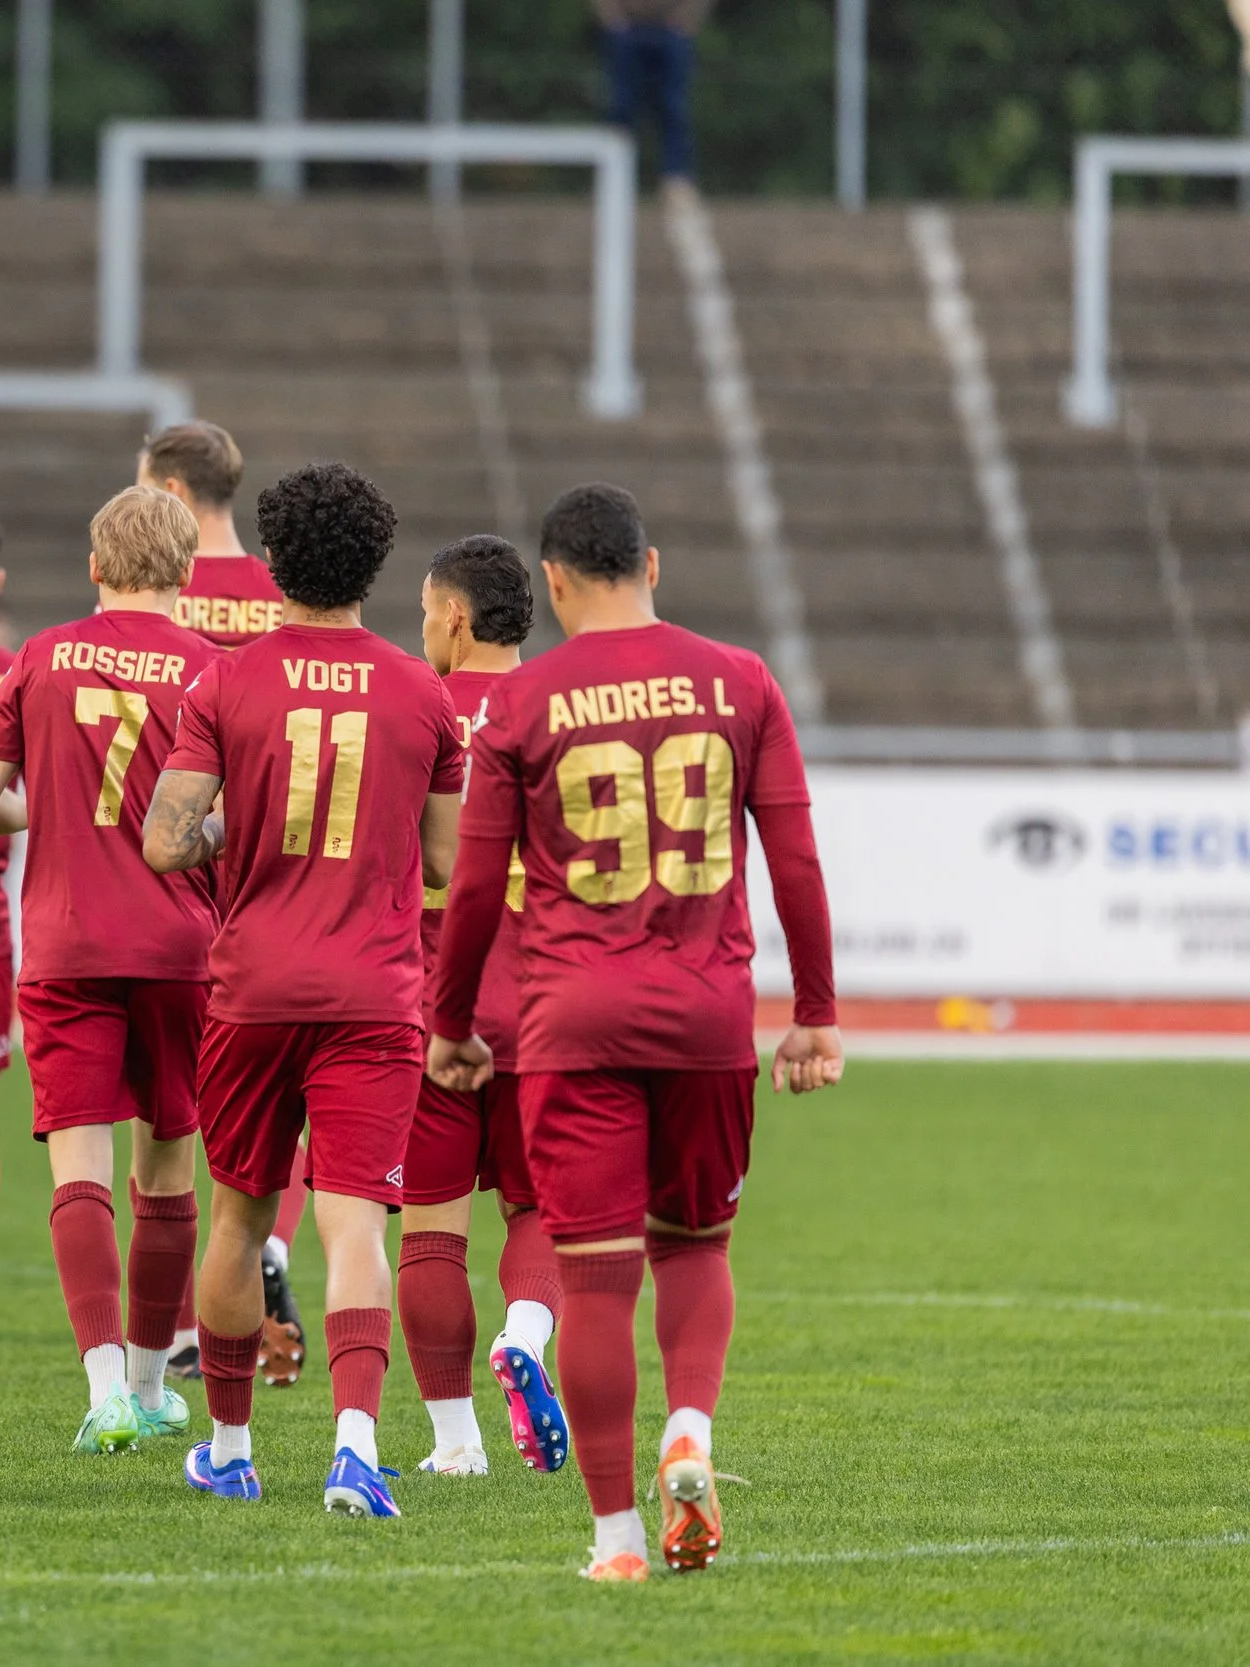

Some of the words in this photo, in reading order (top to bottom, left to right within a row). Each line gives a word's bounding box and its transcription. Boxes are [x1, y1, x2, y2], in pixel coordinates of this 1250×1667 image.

[171, 596, 282, 634] ORENSE
[51, 641, 186, 686] ROSSIER
[282, 658, 375, 694] VOGT
[549, 676, 706, 734] ANDRES.
[713, 677, 736, 717] L
[75, 686, 150, 827] 7
[281, 707, 368, 860] 11
[555, 731, 734, 906] 99
